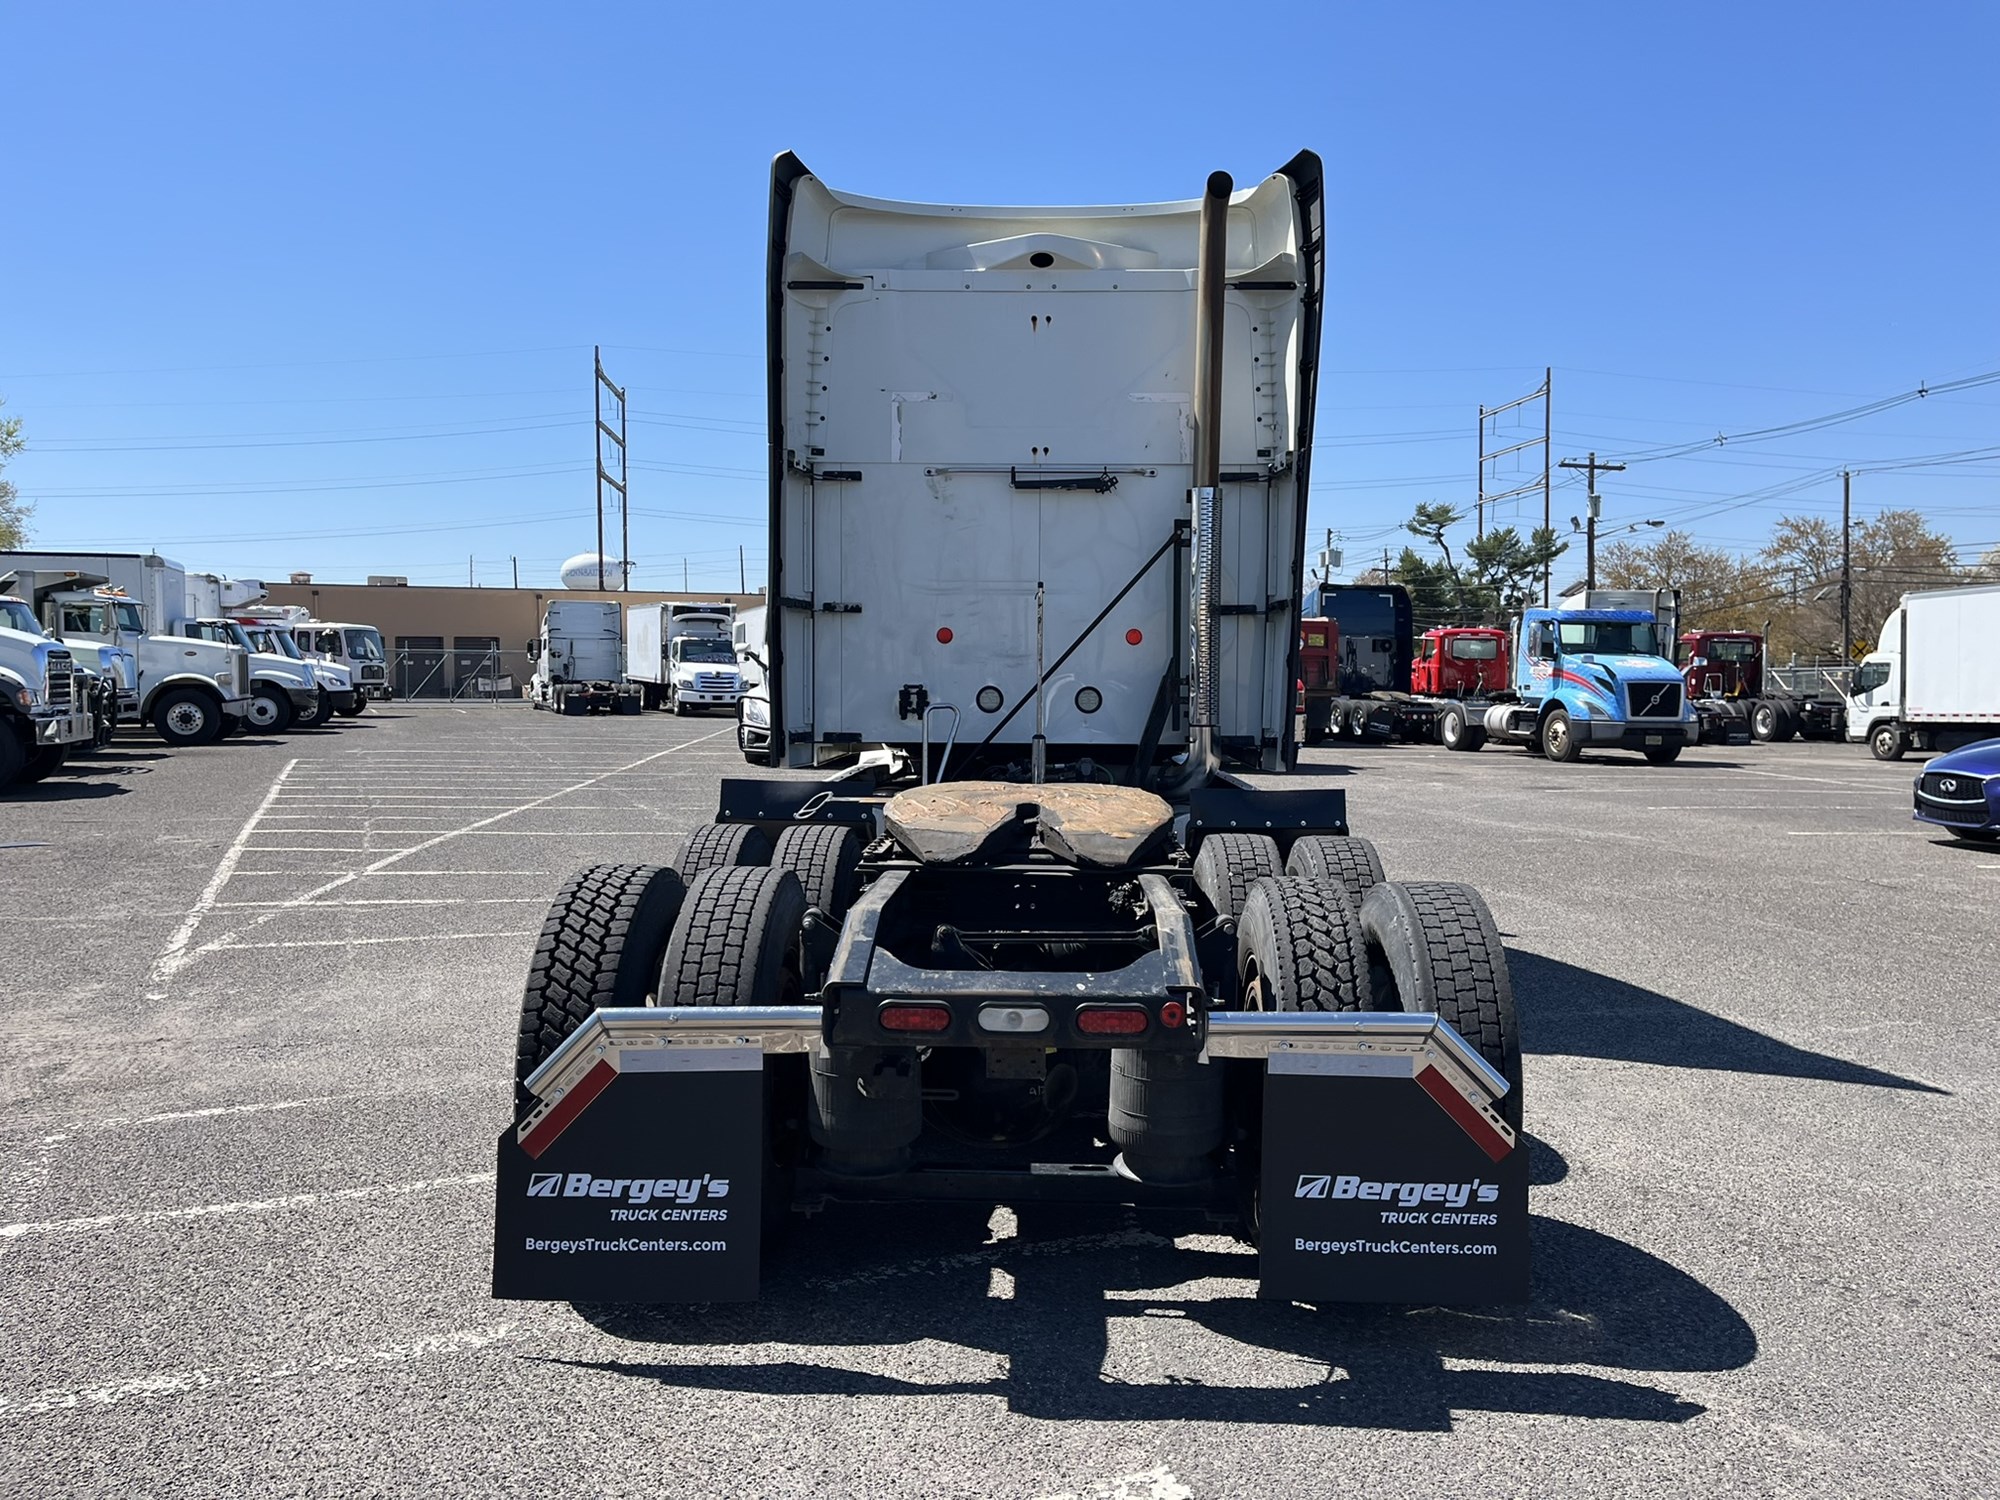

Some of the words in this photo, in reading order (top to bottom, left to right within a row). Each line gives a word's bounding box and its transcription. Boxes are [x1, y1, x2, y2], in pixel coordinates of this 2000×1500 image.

[564, 1174, 729, 1203] Bergey's
[1332, 1176, 1499, 1207] Bergey's
[610, 1209, 659, 1221] TRUCK
[662, 1209, 727, 1220] CENTERS
[1381, 1212, 1429, 1224] TRUCK
[1431, 1213, 1497, 1225] CENTERS
[526, 1238, 726, 1253] BergeysTruckCenters.com
[1295, 1238, 1496, 1254] BergeysTruckCenters.com
